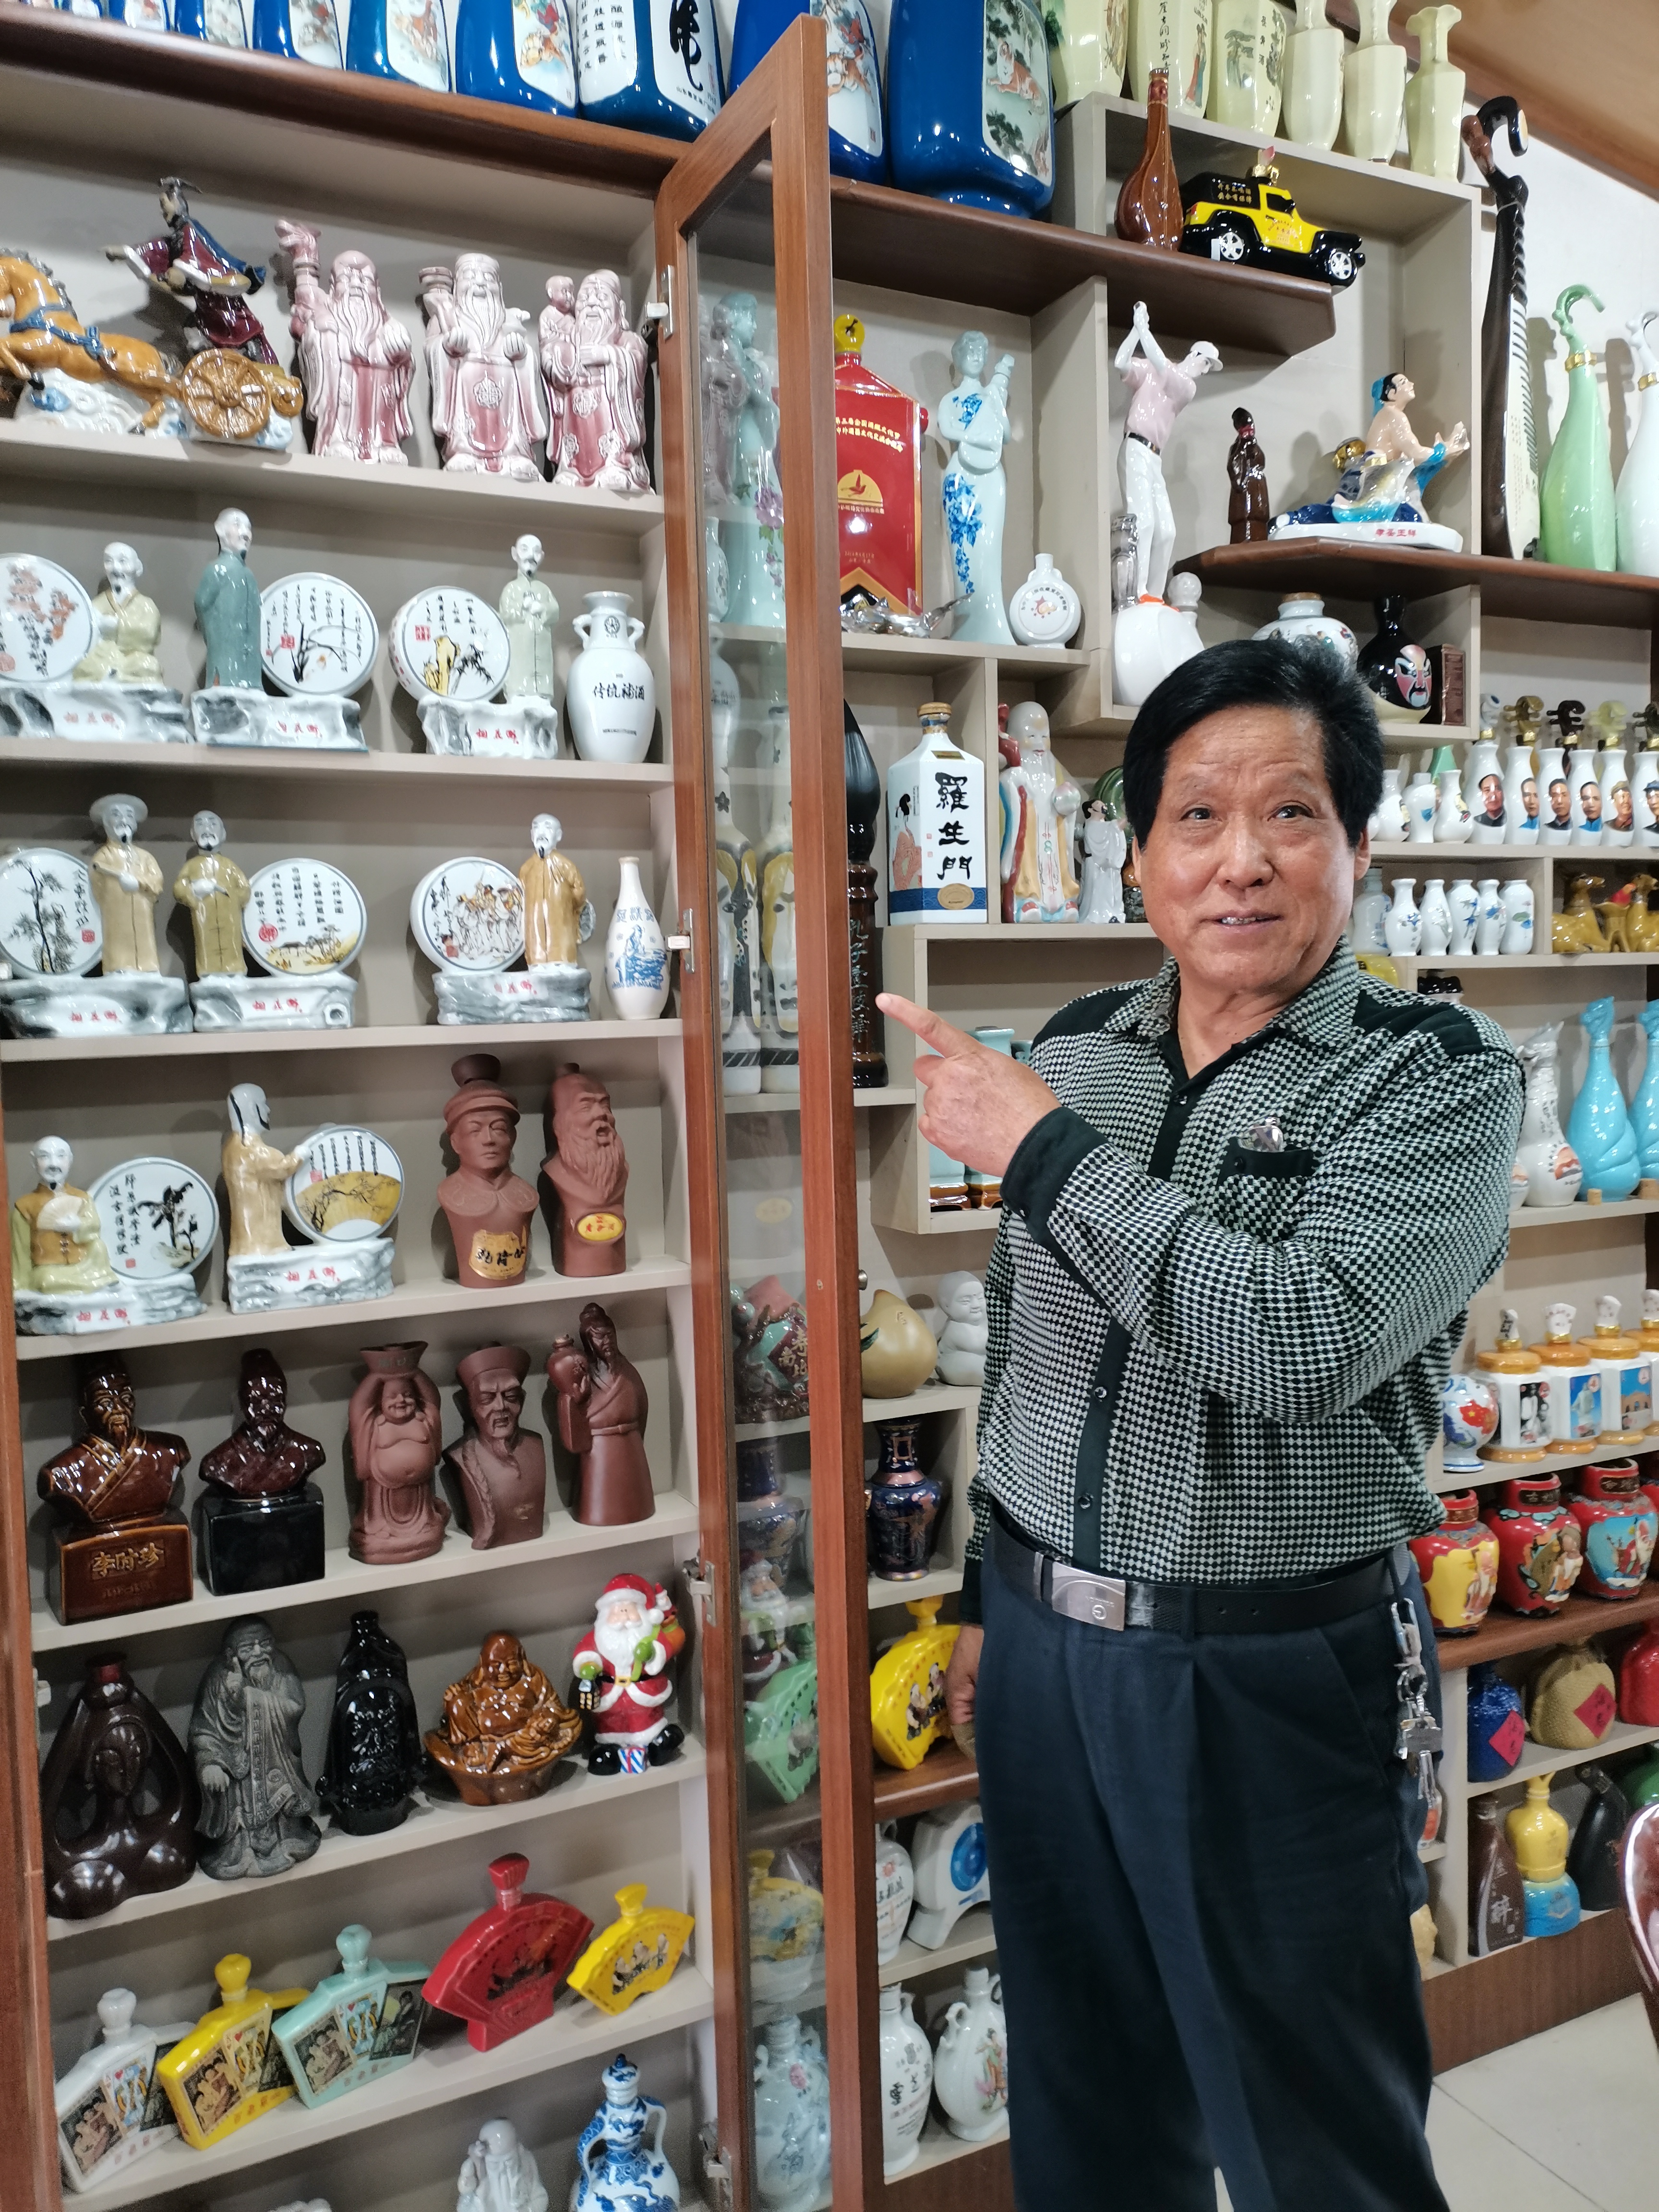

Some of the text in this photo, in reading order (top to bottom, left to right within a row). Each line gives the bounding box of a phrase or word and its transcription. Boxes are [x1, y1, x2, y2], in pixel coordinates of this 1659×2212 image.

[935, 771, 973, 881] 羅生門
[92, 1542, 164, 1577] 李时珍
